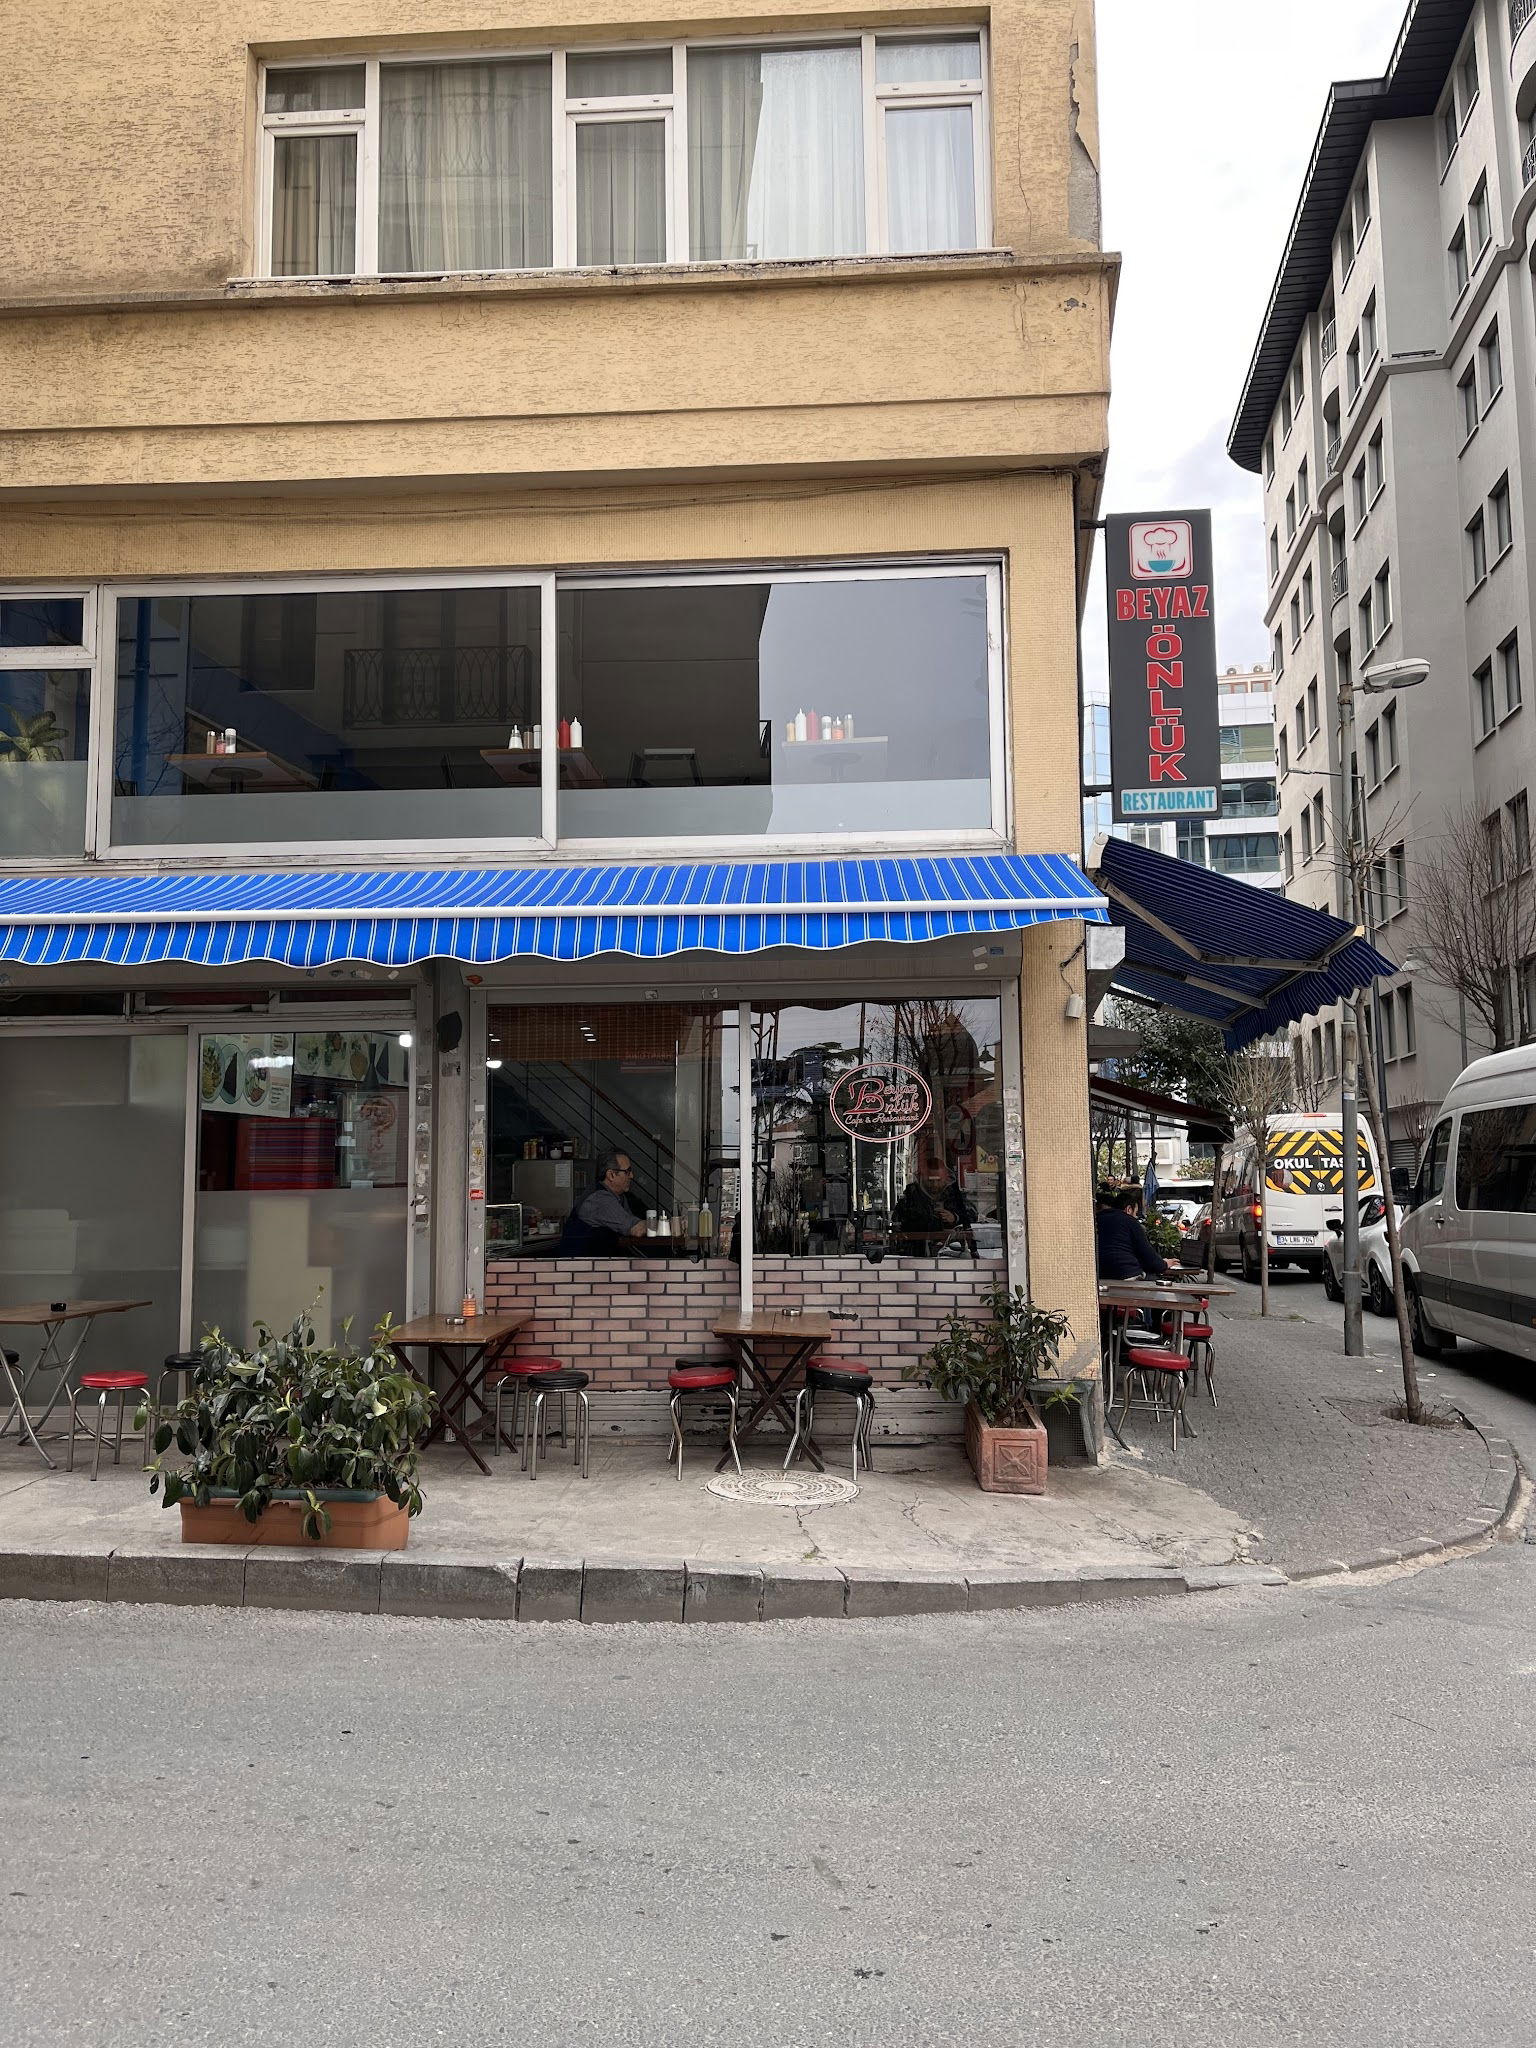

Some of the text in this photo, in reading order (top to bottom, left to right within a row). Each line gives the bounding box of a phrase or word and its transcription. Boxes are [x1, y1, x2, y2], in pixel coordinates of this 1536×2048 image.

[1116, 585, 1209, 620] BEYAZ
[1145, 624, 1187, 782] ÖNLÜK
[1123, 790, 1215, 811] RESTAURANT
[1273, 1157, 1314, 1170] OKUL
